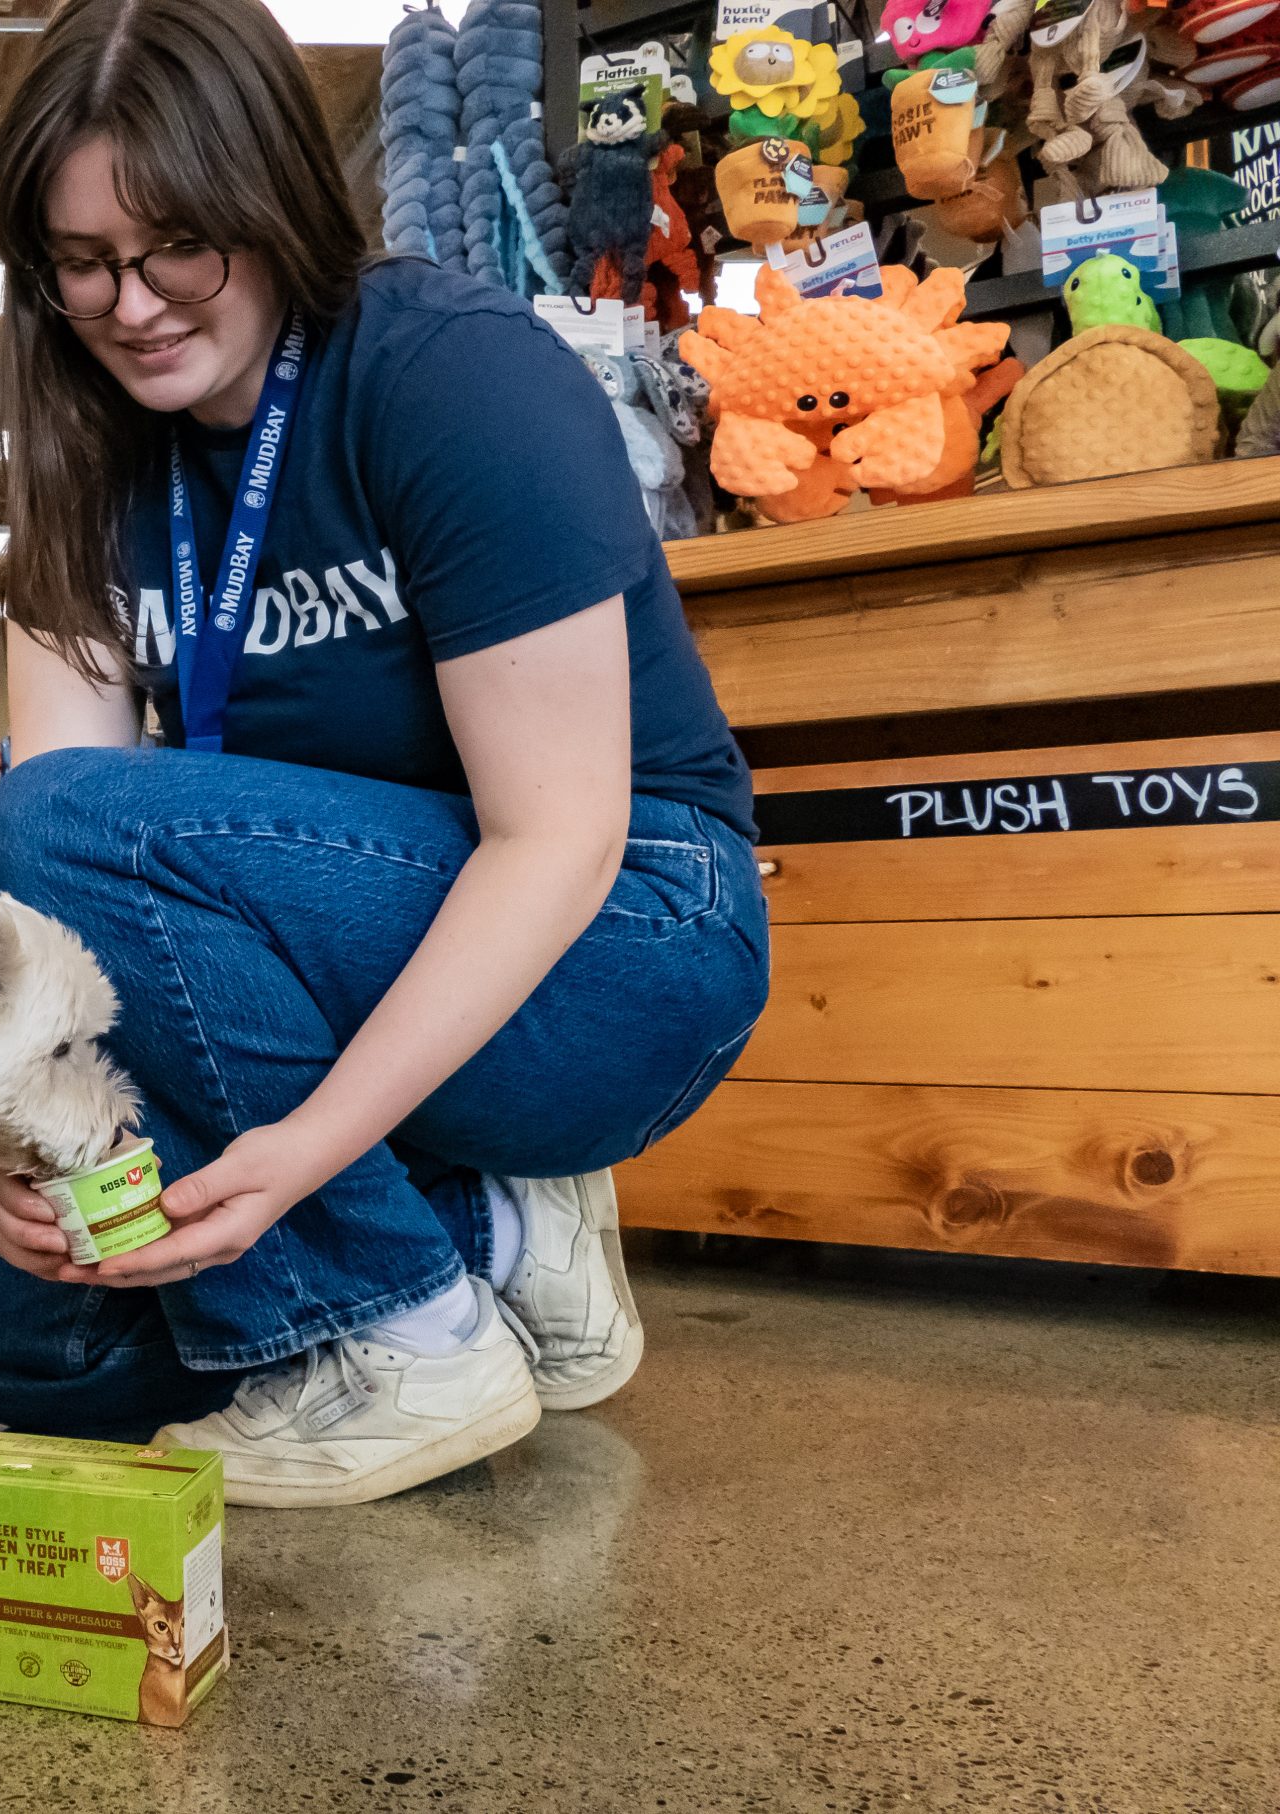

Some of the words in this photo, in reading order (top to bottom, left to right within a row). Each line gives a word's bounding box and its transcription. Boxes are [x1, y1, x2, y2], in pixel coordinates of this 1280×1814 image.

[723, 6, 771, 16] huxley
[596, 66, 647, 81] Flatties
[894, 102, 933, 126] OSIE
[1108, 197, 1151, 211] PETLOU
[830, 231, 864, 250] PETLOU
[247, 404, 287, 491] MUDBAY
[219, 530, 255, 615] MUDBAY
[136, 546, 410, 665] MDBAY
[178, 559, 197, 637] MUDBAY
[885, 780, 1070, 838] PLUSH
[1092, 767, 1259, 818] TOYS
[100, 1177, 127, 1194] BOSS
[311, 1394, 357, 1427] Reebo
[25, 1528, 66, 1543] STYLE
[26, 1543, 89, 1563] YOGURT
[99, 1555, 126, 1567] BOSS
[17, 1559, 67, 1578] TREAT
[103, 1565, 122, 1577] CAT
[3, 1605, 43, 1618] BUTTER
[45, 1611, 52, 1620] &
[55, 1612, 123, 1630] APPLESAUCE
[3, 1627, 28, 1638] TREAT
[30, 1630, 52, 1640] MADE
[52, 1633, 73, 1643] WITH
[75, 1636, 94, 1648] REAL
[95, 1639, 128, 1650] YOGURT
